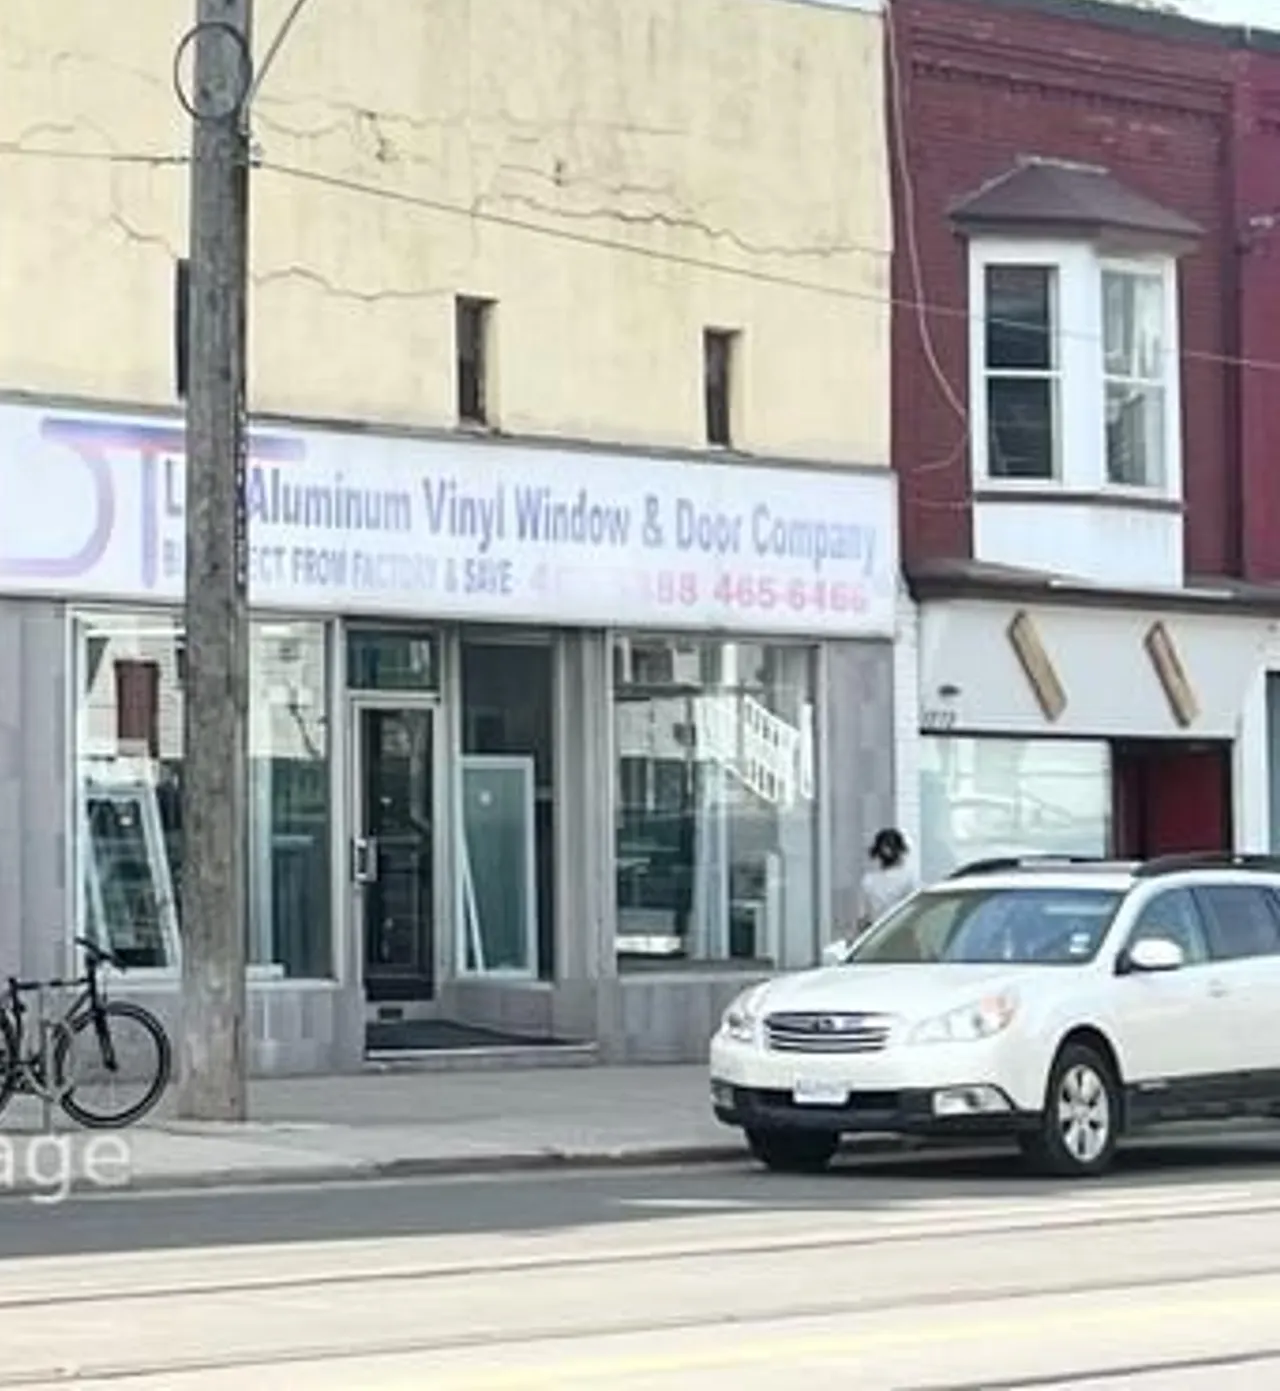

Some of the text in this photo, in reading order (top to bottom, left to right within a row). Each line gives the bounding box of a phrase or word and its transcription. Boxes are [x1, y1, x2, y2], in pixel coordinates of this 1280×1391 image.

[247, 466, 412, 532] Aluminum
[422, 476, 506, 554] Vinyl
[514, 483, 630, 546] Window
[642, 492, 663, 548] &
[675, 497, 742, 555] Door
[751, 503, 878, 576] Company
[292, 547, 347, 588] FROM
[463, 558, 514, 595] SAVE
